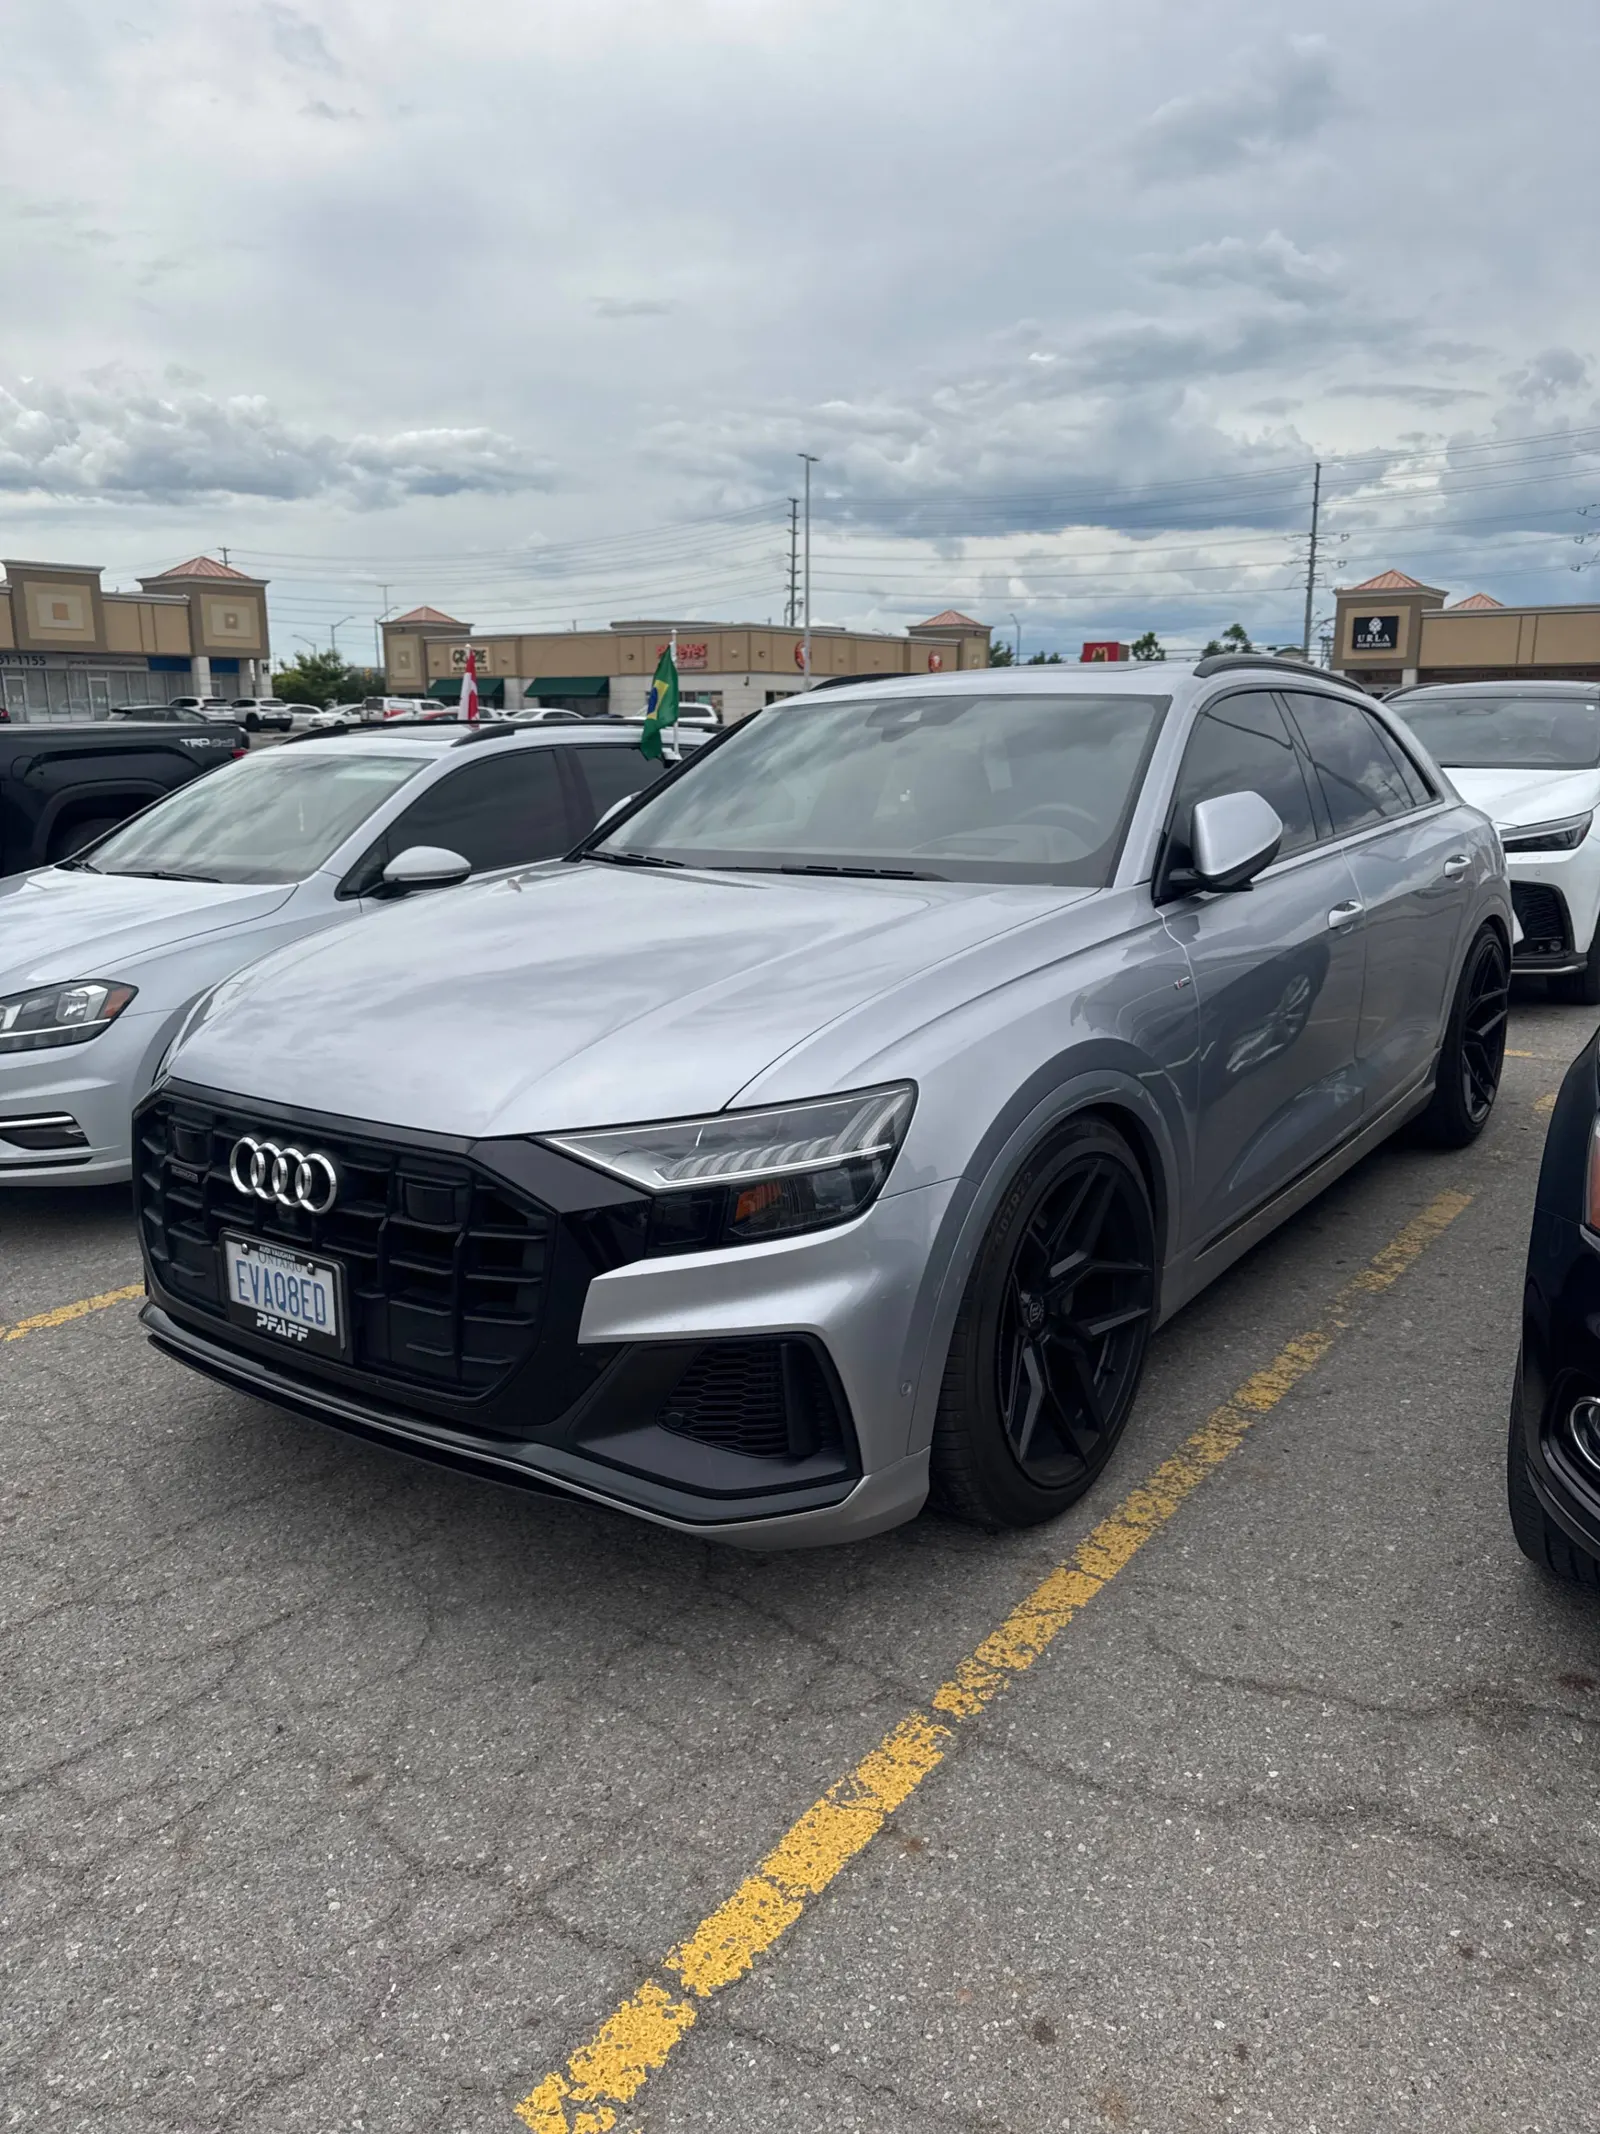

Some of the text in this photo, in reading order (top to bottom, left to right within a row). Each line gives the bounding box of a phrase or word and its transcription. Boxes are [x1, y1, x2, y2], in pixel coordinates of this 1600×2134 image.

[1357, 634, 1390, 642] URLA
[262, 663, 270, 674] H
[179, 738, 211, 748] TRD
[257, 1250, 303, 1273] ONTARIO
[271, 1248, 296, 1262] VAUGHAN
[235, 1259, 327, 1326] EVAQ8ED
[256, 1312, 309, 1342] PFAFF
